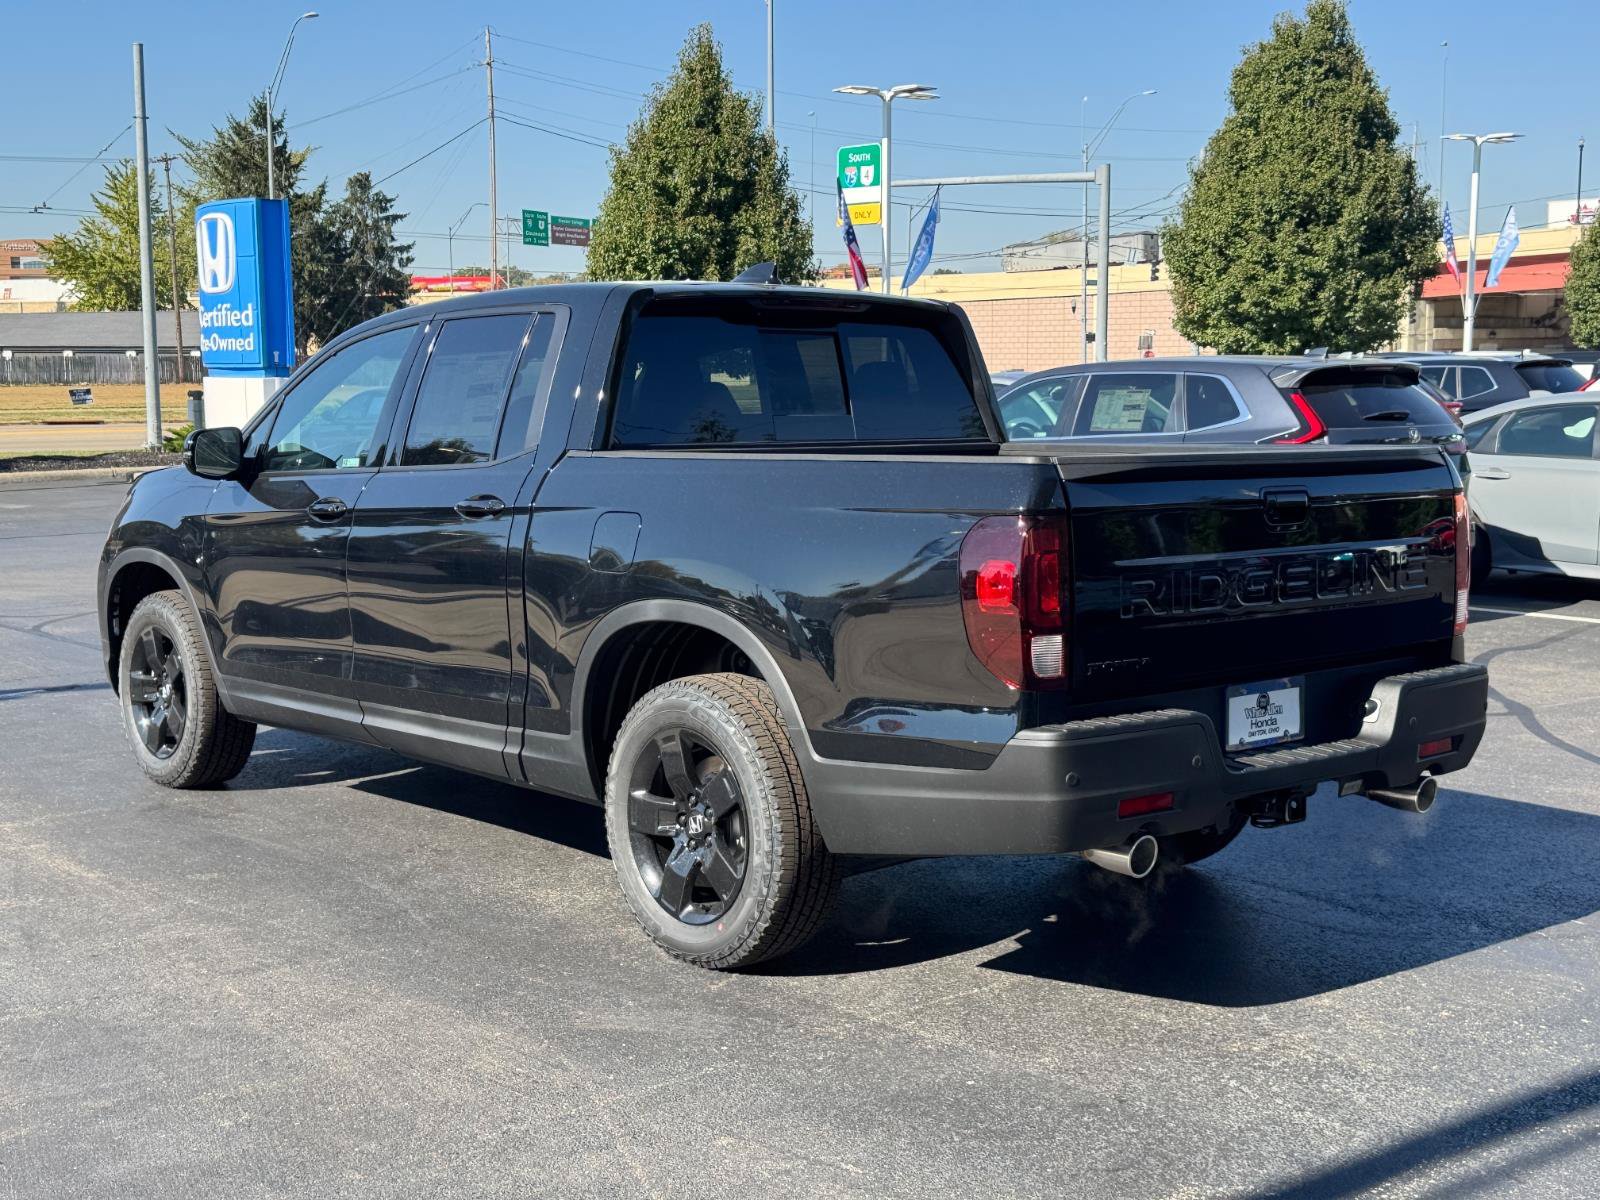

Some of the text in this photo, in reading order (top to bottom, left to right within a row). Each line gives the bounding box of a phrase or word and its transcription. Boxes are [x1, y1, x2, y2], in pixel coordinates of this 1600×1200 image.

[863, 169, 870, 181] 4
[854, 211, 872, 219] ONLY
[199, 303, 253, 328] Certified
[1120, 549, 1428, 619] RIDGELINE
[1250, 716, 1278, 729] Honda
